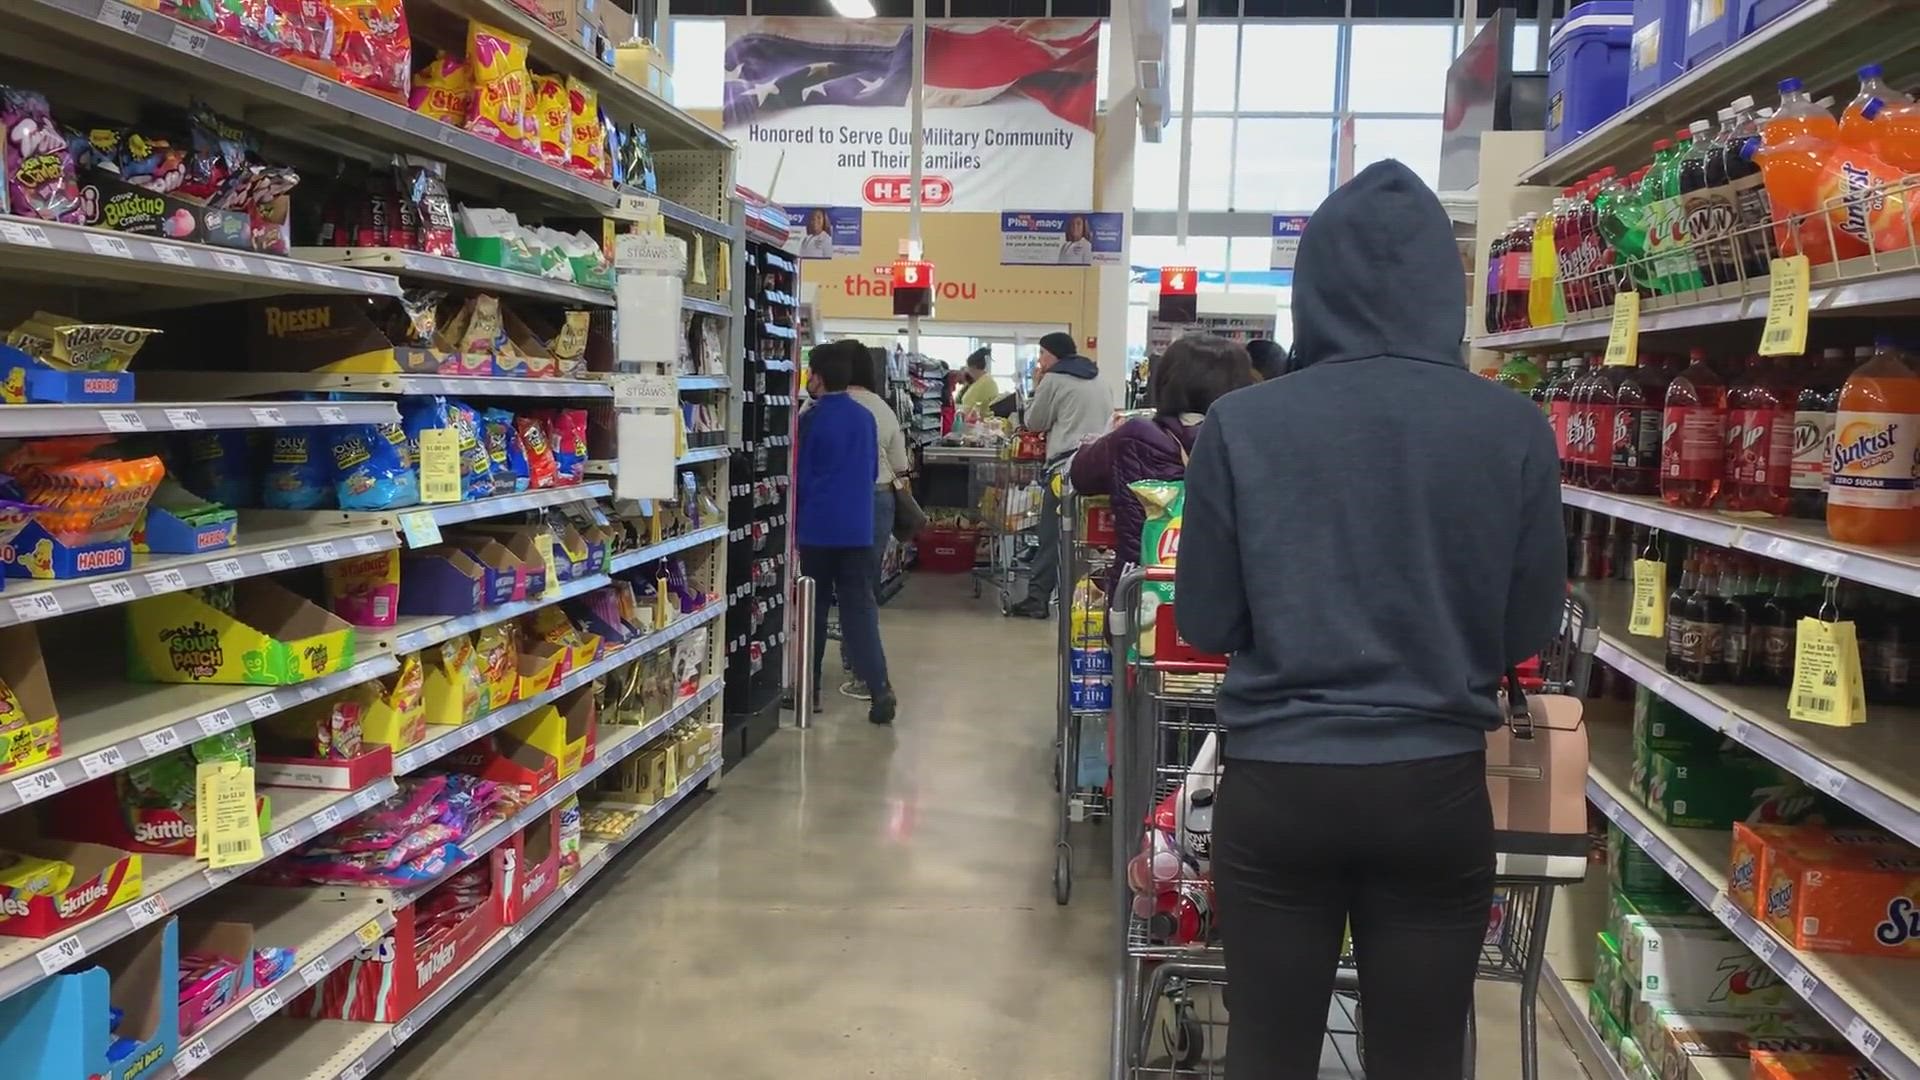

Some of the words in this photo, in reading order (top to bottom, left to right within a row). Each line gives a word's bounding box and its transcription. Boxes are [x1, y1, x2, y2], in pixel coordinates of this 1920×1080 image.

[749, 124, 813, 144] Honored
[819, 126, 834, 144] to
[839, 126, 882, 145] Serve
[984, 127, 1074, 150] Community
[837, 151, 865, 168] and
[871, 151, 910, 168] Their
[921, 152, 981, 170] amilies
[104, 194, 165, 226] Bursting
[627, 247, 668, 259] STRAWS
[1169, 272, 1185, 291] 4
[265, 306, 331, 337] RIESEN
[67, 327, 141, 349] HARIBO
[84, 378, 119, 394] HARIBO
[626, 386, 667, 397] STRAWS
[1833, 423, 1899, 474] Sunkist
[77, 548, 126, 571] HARIBO
[172, 635, 217, 651] SOUR
[172, 651, 223, 667] PATCH
[135, 820, 197, 842] Skittle
[1805, 870, 1824, 885] 12
[60, 882, 109, 919] Skittles
[1647, 939, 1659, 949] 12
